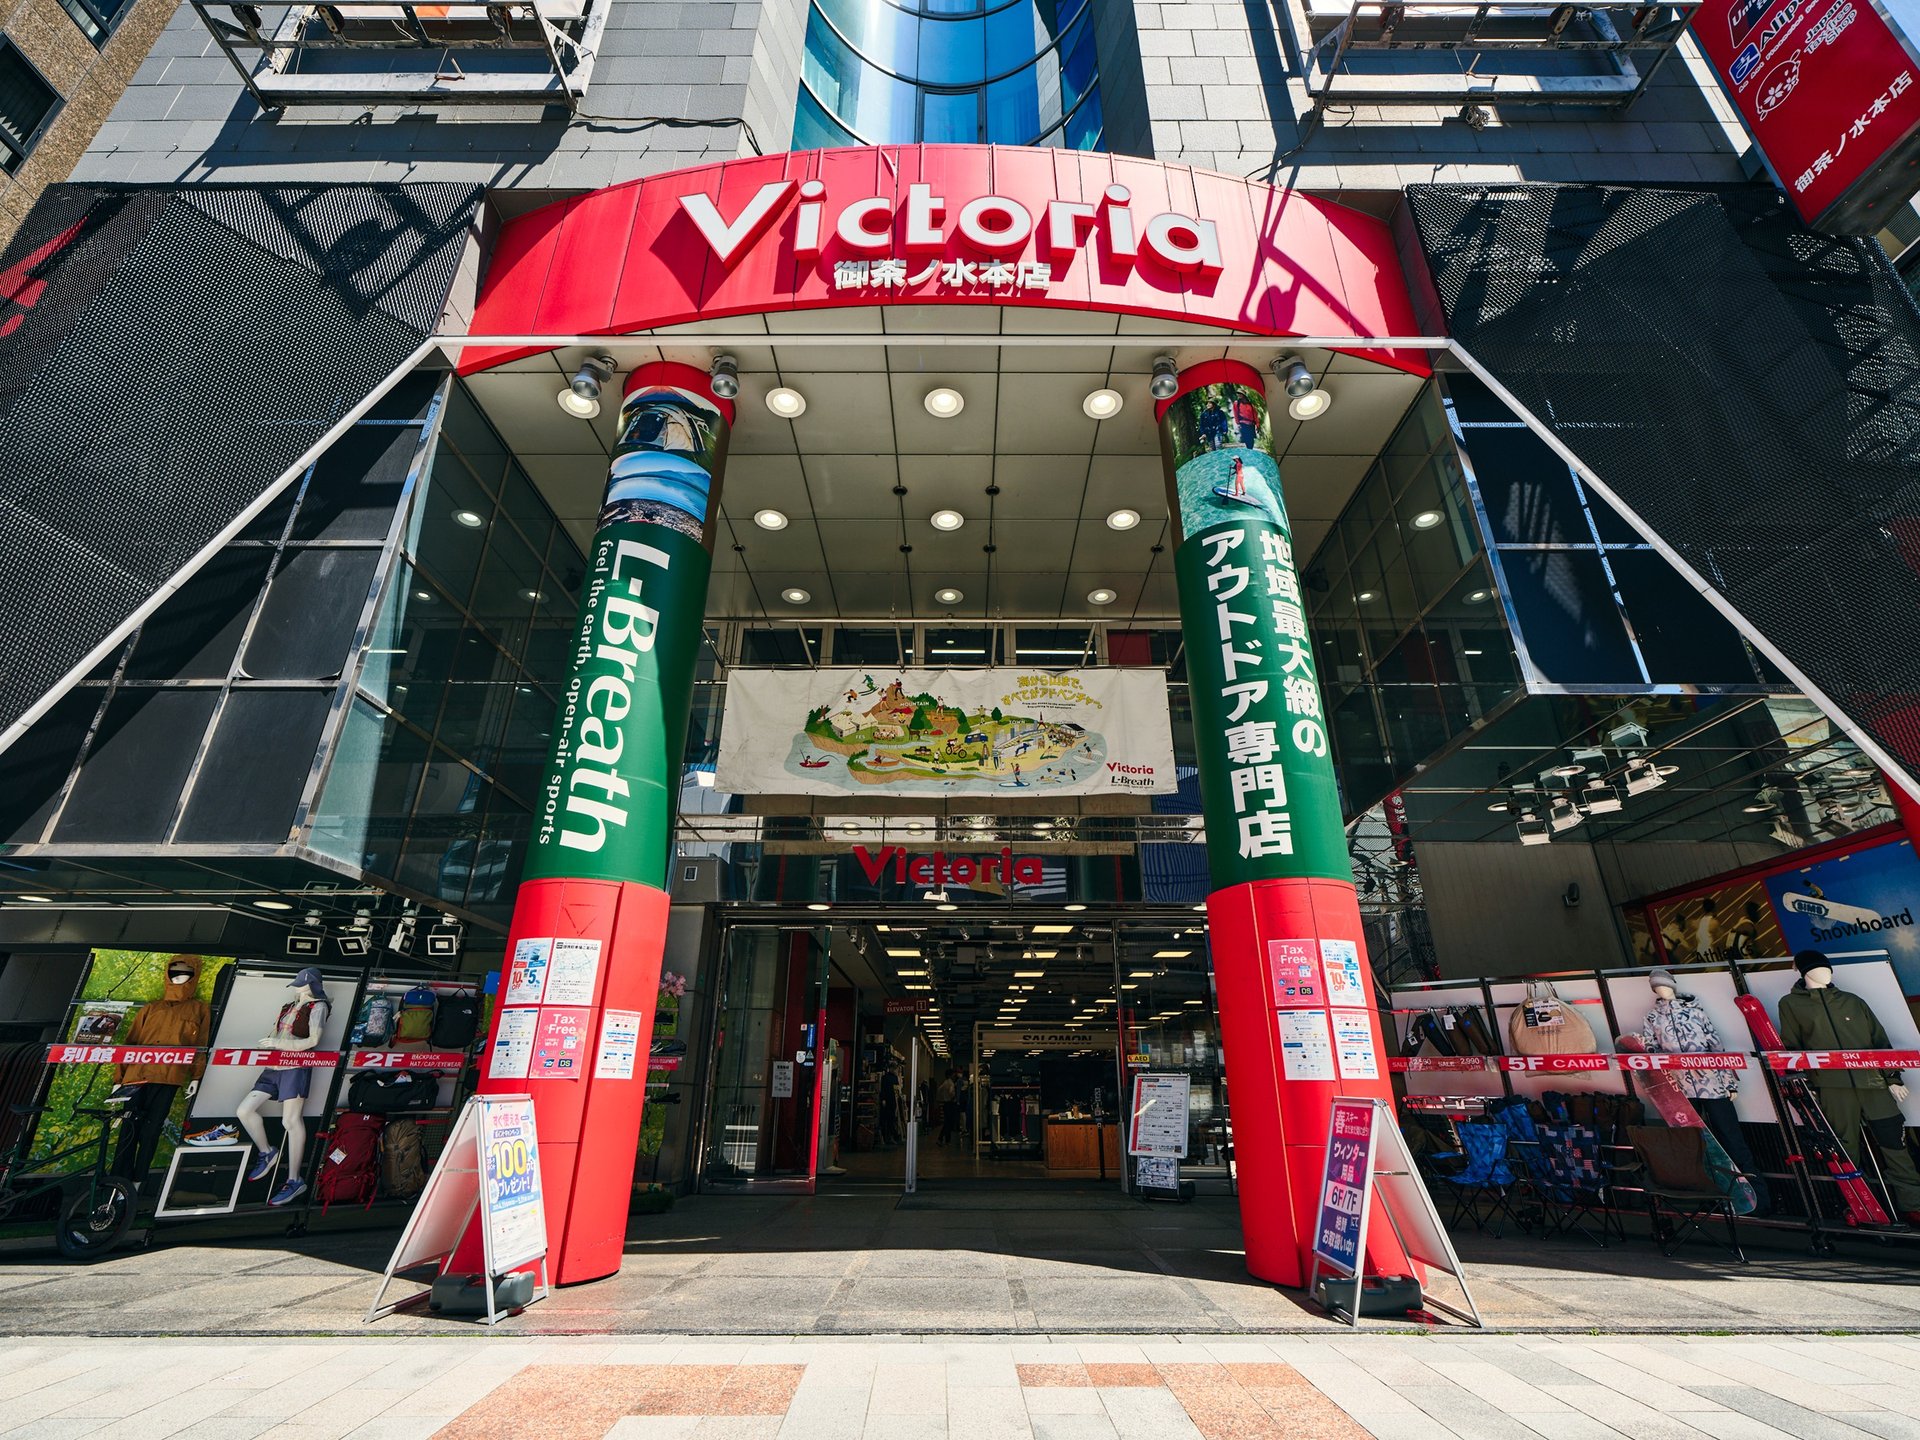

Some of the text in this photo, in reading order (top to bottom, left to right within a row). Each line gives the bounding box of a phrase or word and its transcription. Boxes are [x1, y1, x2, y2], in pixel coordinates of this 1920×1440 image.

[1803, 3, 1853, 54] Tax-free
[1824, 9, 1858, 46] Shop
[1794, 70, 1913, 193] 御茶ノ水本店
[678, 179, 1224, 277] Victoria
[833, 258, 1052, 291] 御茶ノ水本店
[1259, 529, 1327, 759] 地域最大級の
[539, 540, 614, 844] feel the earth, open-air sports
[559, 539, 671, 854] L-Breath
[1201, 528, 1295, 861] アウトドア専門店
[1106, 762, 1154, 775] Victoria
[852, 845, 1043, 886] Victoria
[1810, 907, 1914, 943] Snowboard
[1280, 955, 1308, 964] Free
[1281, 945, 1304, 955] Tax
[553, 1014, 576, 1024] Tax
[548, 1024, 577, 1035] Free
[1022, 1035, 1092, 1044] SALOMON
[60, 1047, 195, 1064] 別館 BICYCLE
[224, 1051, 272, 1066] 1F
[363, 1053, 405, 1067] 2F
[1508, 1057, 1607, 1070] 5F CAMP
[1627, 1056, 1744, 1069] 6F SNOWBOARD
[1777, 1053, 1831, 1068] 7F
[1845, 1060, 1920, 1068] INLINE SKATE
[493, 1113, 520, 1127] すぐ使える
[1335, 1110, 1358, 1134] 春 スキー
[492, 1139, 527, 1179] 100
[1334, 1141, 1365, 1161] ウィンター
[1341, 1164, 1354, 1182] 用品
[1331, 1186, 1357, 1211] 6F/7F
